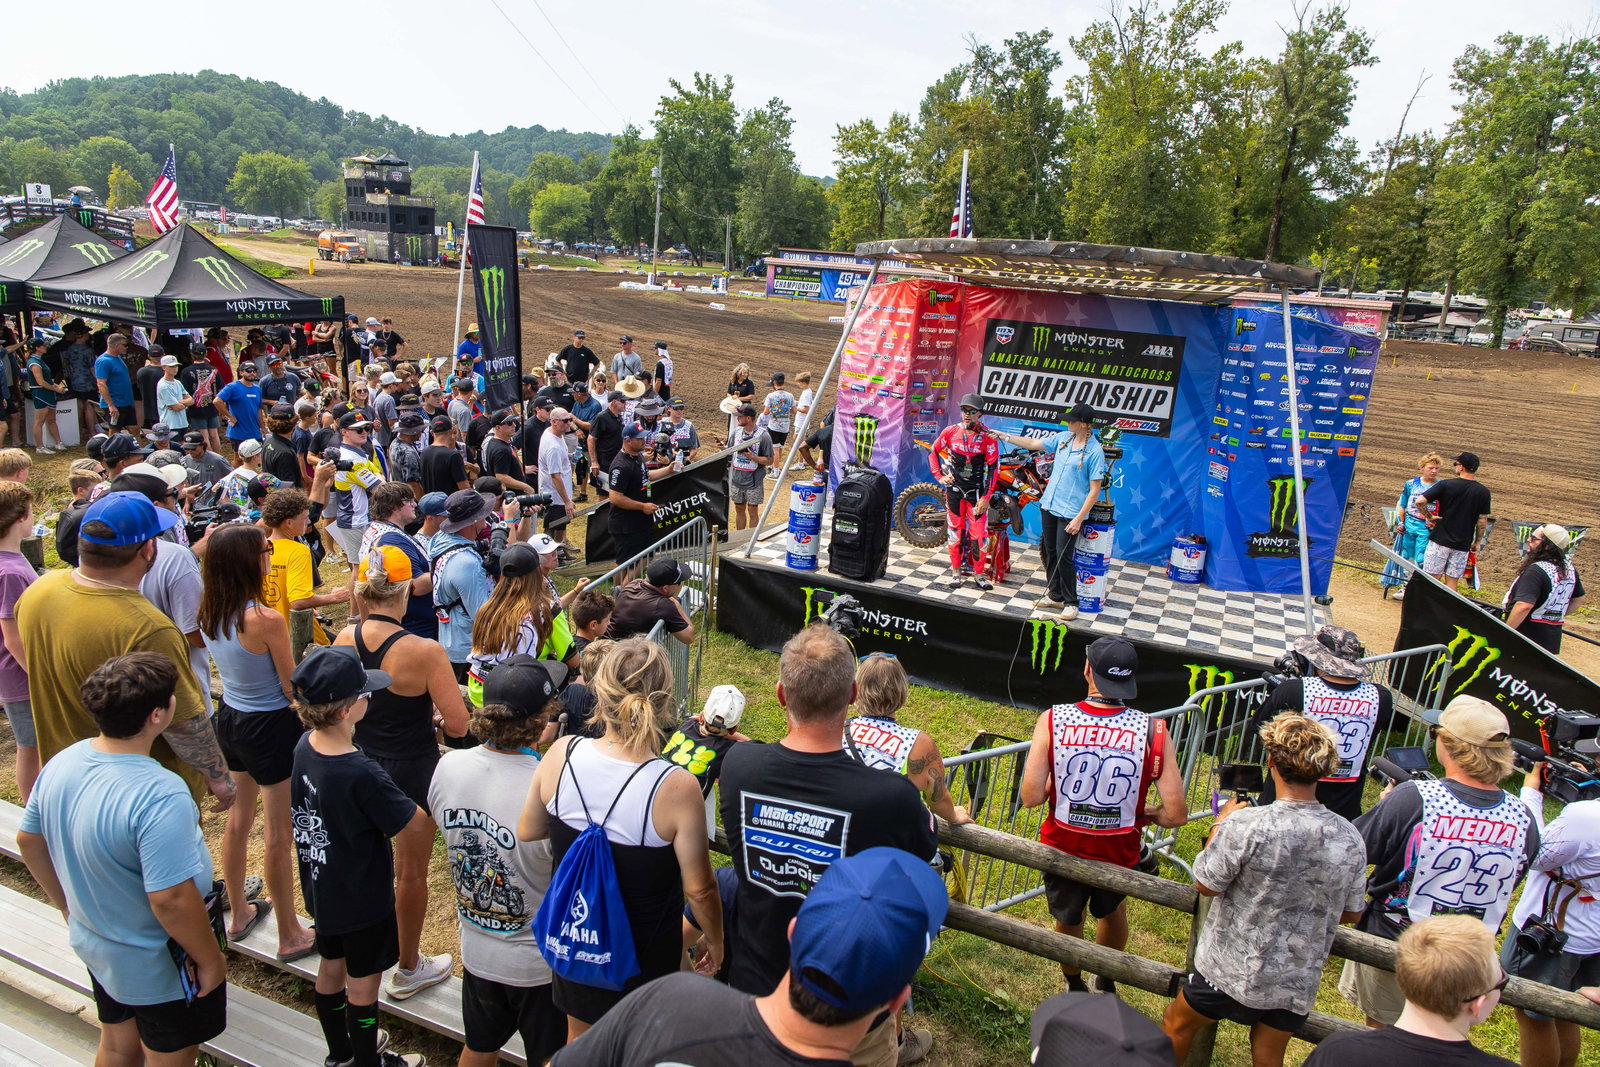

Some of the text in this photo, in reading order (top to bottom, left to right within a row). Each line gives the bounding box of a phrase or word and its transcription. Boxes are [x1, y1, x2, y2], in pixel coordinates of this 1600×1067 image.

[35, 184, 42, 194] 8
[790, 253, 810, 261] YAMAHA
[834, 256, 857, 264] YAMAHA
[774, 280, 820, 292] CHAMPIONSHIP
[841, 274, 852, 285] 45
[64, 292, 110, 307] MONSTER
[226, 299, 290, 312] MONSTER
[1054, 332, 1125, 350] MONSTER
[1063, 346, 1113, 356] ENERGY
[1141, 344, 1175, 359] AMA
[988, 351, 1173, 382] AMATEUR NATIONAL MOTOCROSS
[984, 370, 1168, 414] CHAMPIONSHIP
[983, 403, 1058, 420] AT LORETTA LYNN'S
[1103, 428, 1117, 439] 1
[1112, 418, 1160, 432] AMSOIL
[798, 489, 812, 502] VP
[842, 491, 862, 499] OGIO
[652, 492, 711, 523] ONSTER
[657, 509, 703, 529] ENERGY
[793, 530, 807, 544] VP
[1184, 547, 1196, 559] VP
[861, 606, 929, 636] NSTER
[862, 626, 914, 642] NERGY
[1489, 667, 1566, 716] MONS
[1309, 697, 1371, 718] MEDIA
[1495, 692, 1546, 727] ENER
[1060, 725, 1135, 752] MEDIA
[1151, 756, 1161, 778] Canon
[1060, 751, 1137, 806] 86
[759, 818, 785, 830] YAMAHA
[1070, 814, 1120, 825] CHAMPIONSHIP
[444, 808, 516, 850] LAMBO
[1432, 815, 1518, 848] MEDIA
[750, 835, 834, 859] BLU CRU
[759, 856, 823, 883] Dubois
[1416, 846, 1514, 906] 23
[467, 911, 502, 929] LAND
